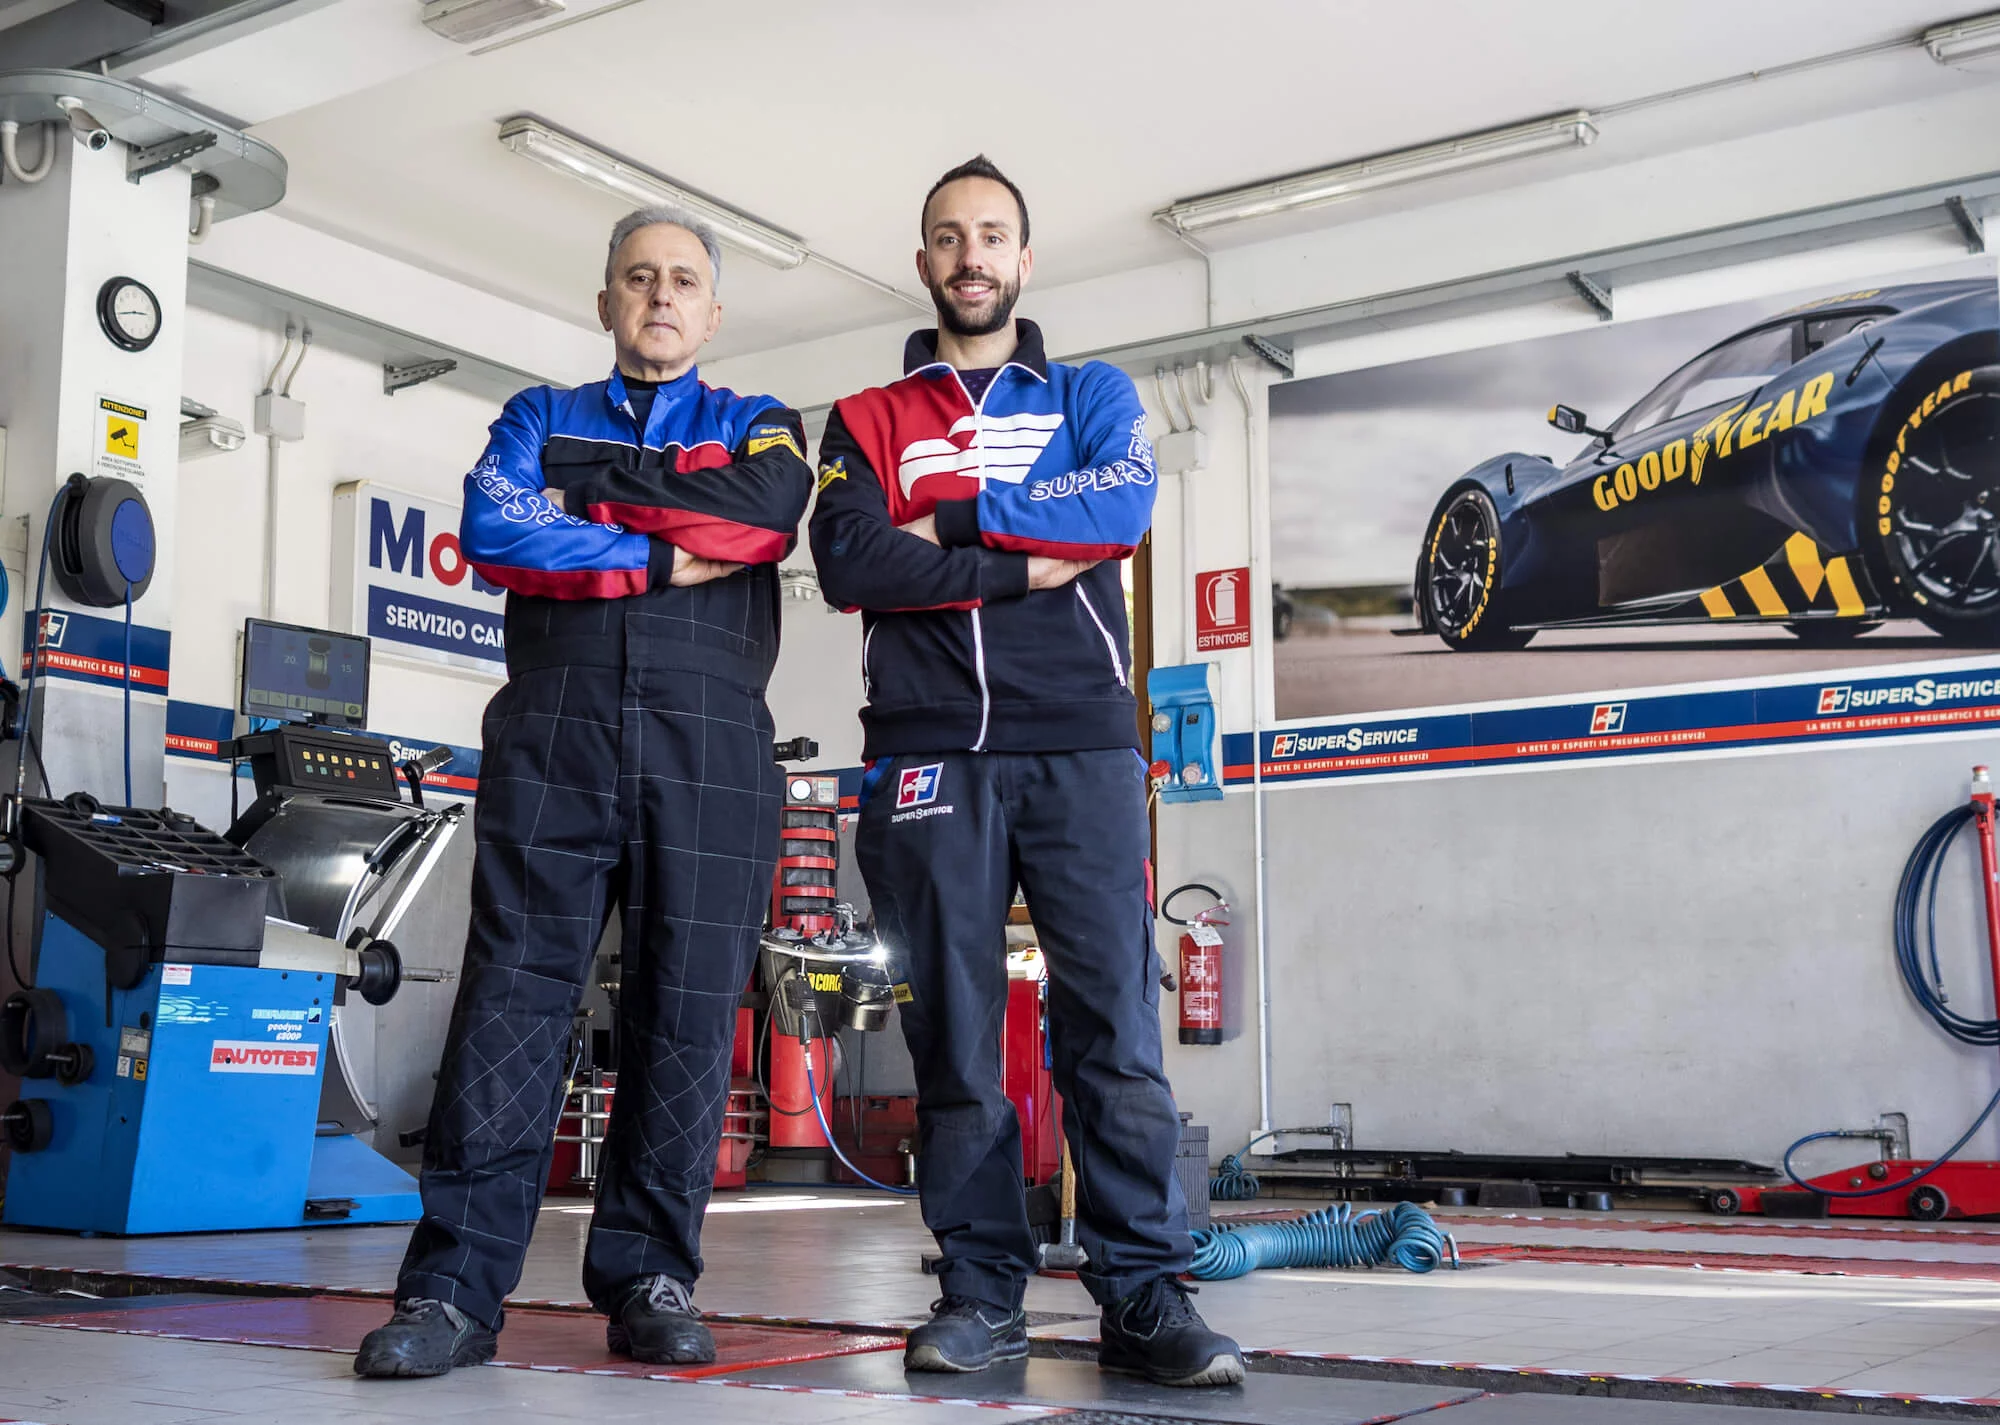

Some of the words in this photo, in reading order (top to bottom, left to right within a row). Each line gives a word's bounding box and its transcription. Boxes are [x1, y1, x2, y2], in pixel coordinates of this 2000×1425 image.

[1593, 371, 1834, 512] GOODYEAR
[386, 604, 467, 640] SERVIZIO
[1198, 632, 1249, 648] ESTINTORE
[48, 656, 99, 672] PNEUMATICI
[101, 664, 107, 673] E
[108, 666, 141, 679] SERIZI
[1806, 723, 1817, 732] LA
[1820, 722, 1842, 730] RETE
[1859, 717, 1897, 728] ESPERTI
[1900, 716, 1911, 724] IN
[1914, 711, 1972, 724] PNEUMATICI
[1975, 710, 1981, 718] E
[180, 739, 184, 747] E
[186, 740, 212, 750] SERVIZI
[1298, 728, 1418, 751] SUPERSERVICE
[1530, 744, 1548, 752] RETE
[1552, 742, 1560, 750] DI
[1563, 740, 1596, 750] ESPERTI
[1600, 738, 1608, 747] IN
[1611, 735, 1662, 746] PNEUMATICI
[1664, 734, 1669, 742] E
[1671, 732, 1706, 742] SERVIZI
[1274, 764, 1291, 772] RETE
[1304, 761, 1333, 770] ESPERTI
[1346, 757, 1390, 766] PNEUMATICI
[1400, 754, 1428, 762] SERVIZI
[891, 805, 954, 823] SUPERSERVICE
